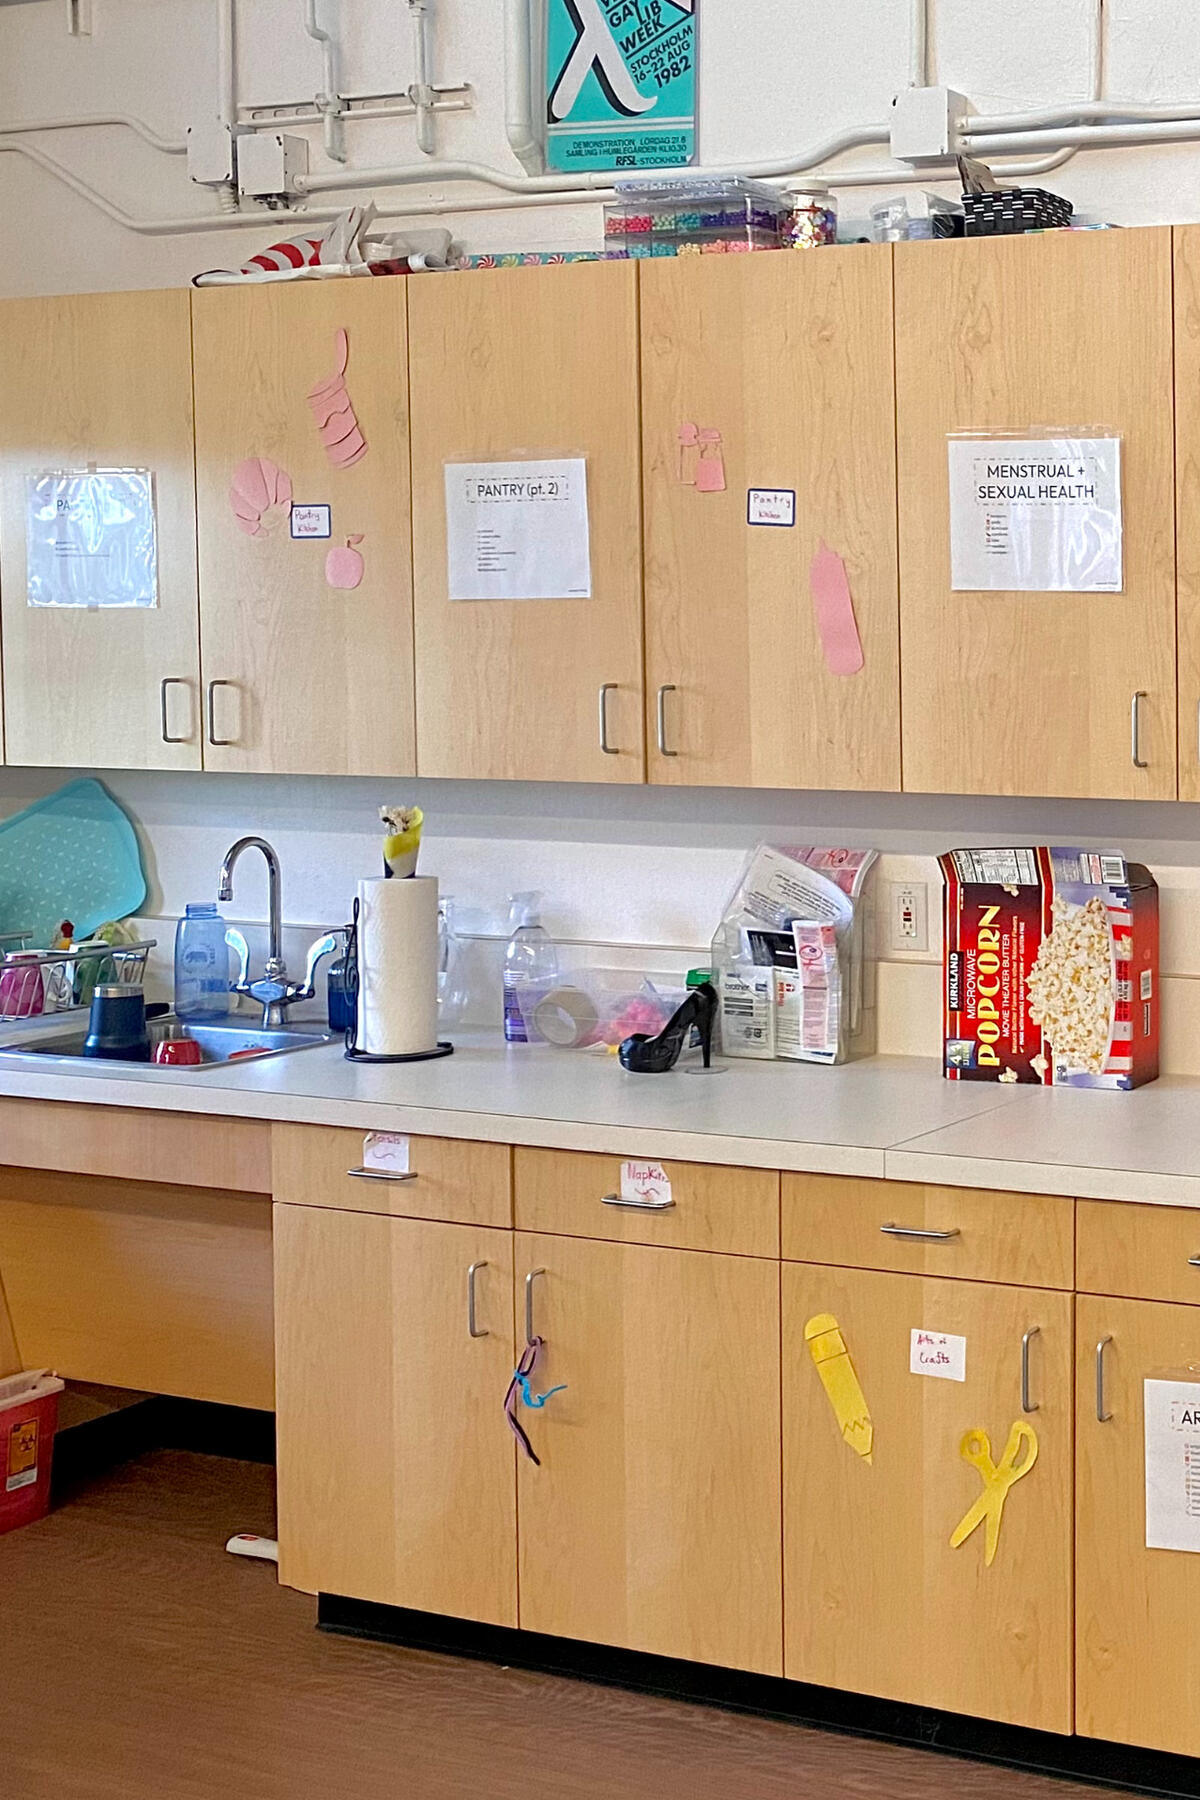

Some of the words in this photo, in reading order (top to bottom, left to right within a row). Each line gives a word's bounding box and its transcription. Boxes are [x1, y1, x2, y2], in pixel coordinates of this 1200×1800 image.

[609, 0, 643, 28] GAY
[637, 0, 662, 25] LIB
[619, 14, 666, 53] WEEK
[630, 25, 693, 73] STOCKHOLM
[667, 40, 691, 62] AUG
[654, 55, 692, 88] 1982
[572, 139, 636, 149] DEMONSTRATION
[986, 464, 1075, 479] MENSTRUAL
[1077, 467, 1086, 475] +
[477, 482, 525, 498] PANTRY
[527, 482, 546, 498] (pt.
[547, 481, 559, 497] 2)
[753, 493, 791, 509] Pantry
[978, 485, 1036, 500] SEXUAL
[1038, 484, 1095, 499] HEALTH
[294, 509, 320, 521] Pantry
[1002, 933, 1010, 967] BUTTER
[950, 952, 959, 1009] KIRKLAND
[966, 949, 976, 1019] MICROWAVE
[977, 905, 1001, 1066] POPCORN
[1002, 969, 1010, 1007] THEATER
[1002, 1008, 1010, 1038] MOVIE
[919, 1351, 950, 1364] Crafts
